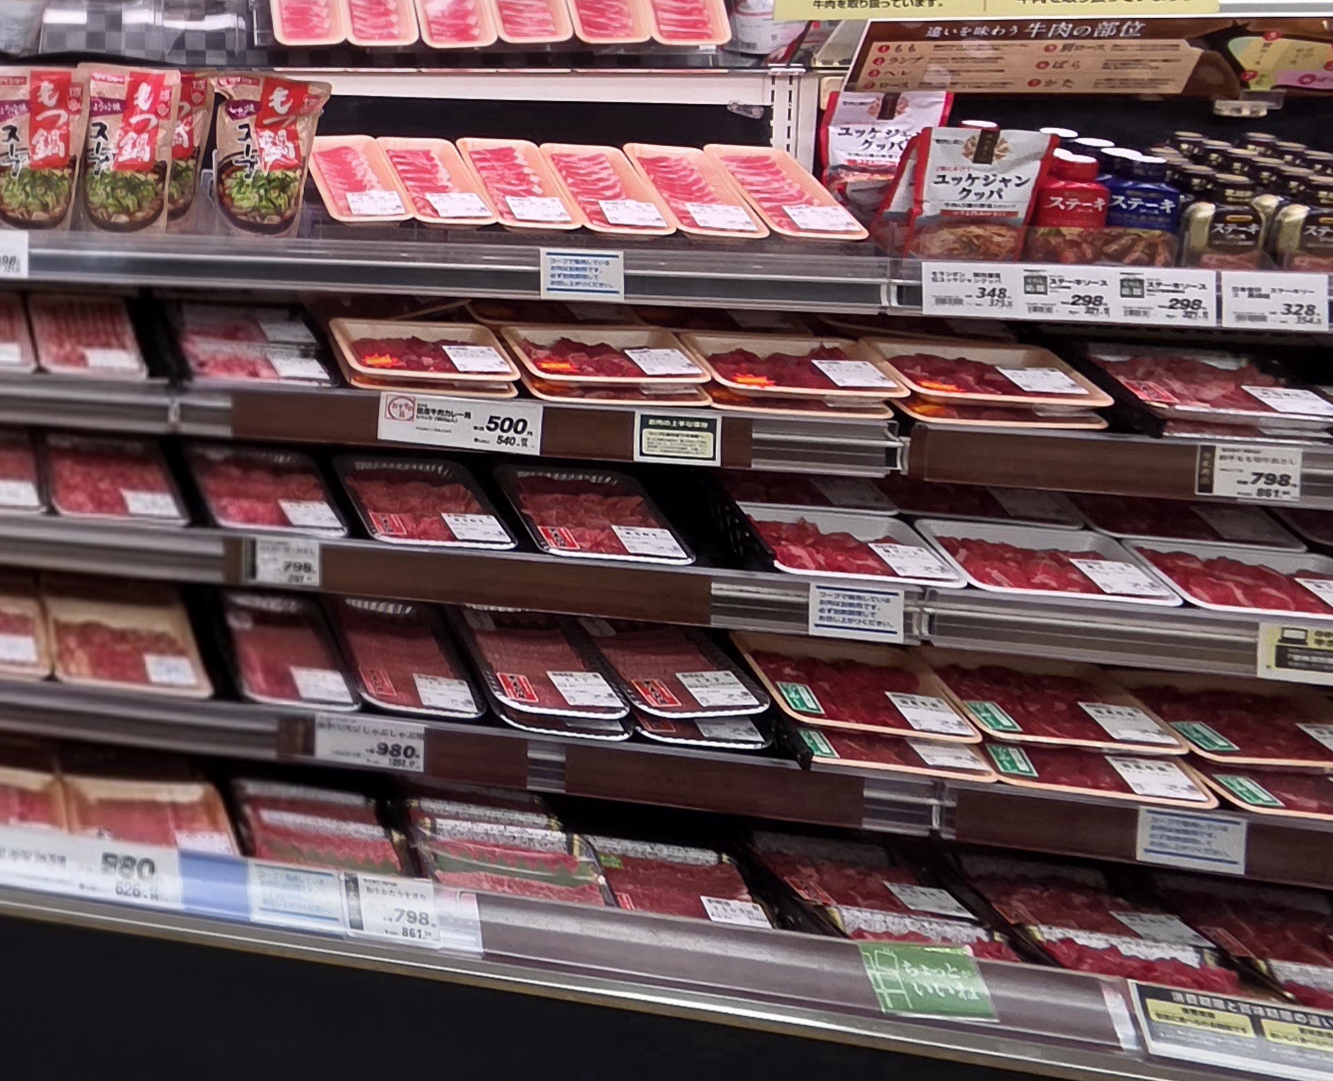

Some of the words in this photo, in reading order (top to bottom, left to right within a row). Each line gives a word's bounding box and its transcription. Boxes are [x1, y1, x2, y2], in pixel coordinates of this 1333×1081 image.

[813, 0, 943, 10] 牛肉を取り扱っています。
[32, 80, 69, 162] もつ鍋
[117, 82, 159, 163] もつ鍋
[934, 174, 1031, 189] ユッケジャン
[958, 187, 1004, 201] クッパ
[1047, 195, 1107, 212] ステーキ
[1110, 194, 1176, 214] ステーキ
[1211, 221, 1260, 235] ステーキ
[1305, 225, 1333, 236] ステー
[1049, 278, 1109, 287] ステーキソース
[1146, 281, 1208, 290] ステーキソース
[976, 287, 1007, 299] 348
[1070, 294, 1105, 307] 298
[1168, 297, 1203, 310] 298
[1281, 303, 1317, 316] 328
[485, 415, 528, 435] 500
[1250, 472, 1292, 487] 798
[284, 561, 312, 574] 798
[376, 742, 416, 759] 980
[100, 851, 156, 882] 580
[393, 907, 430, 927] 798
[401, 926, 423, 940] 861
